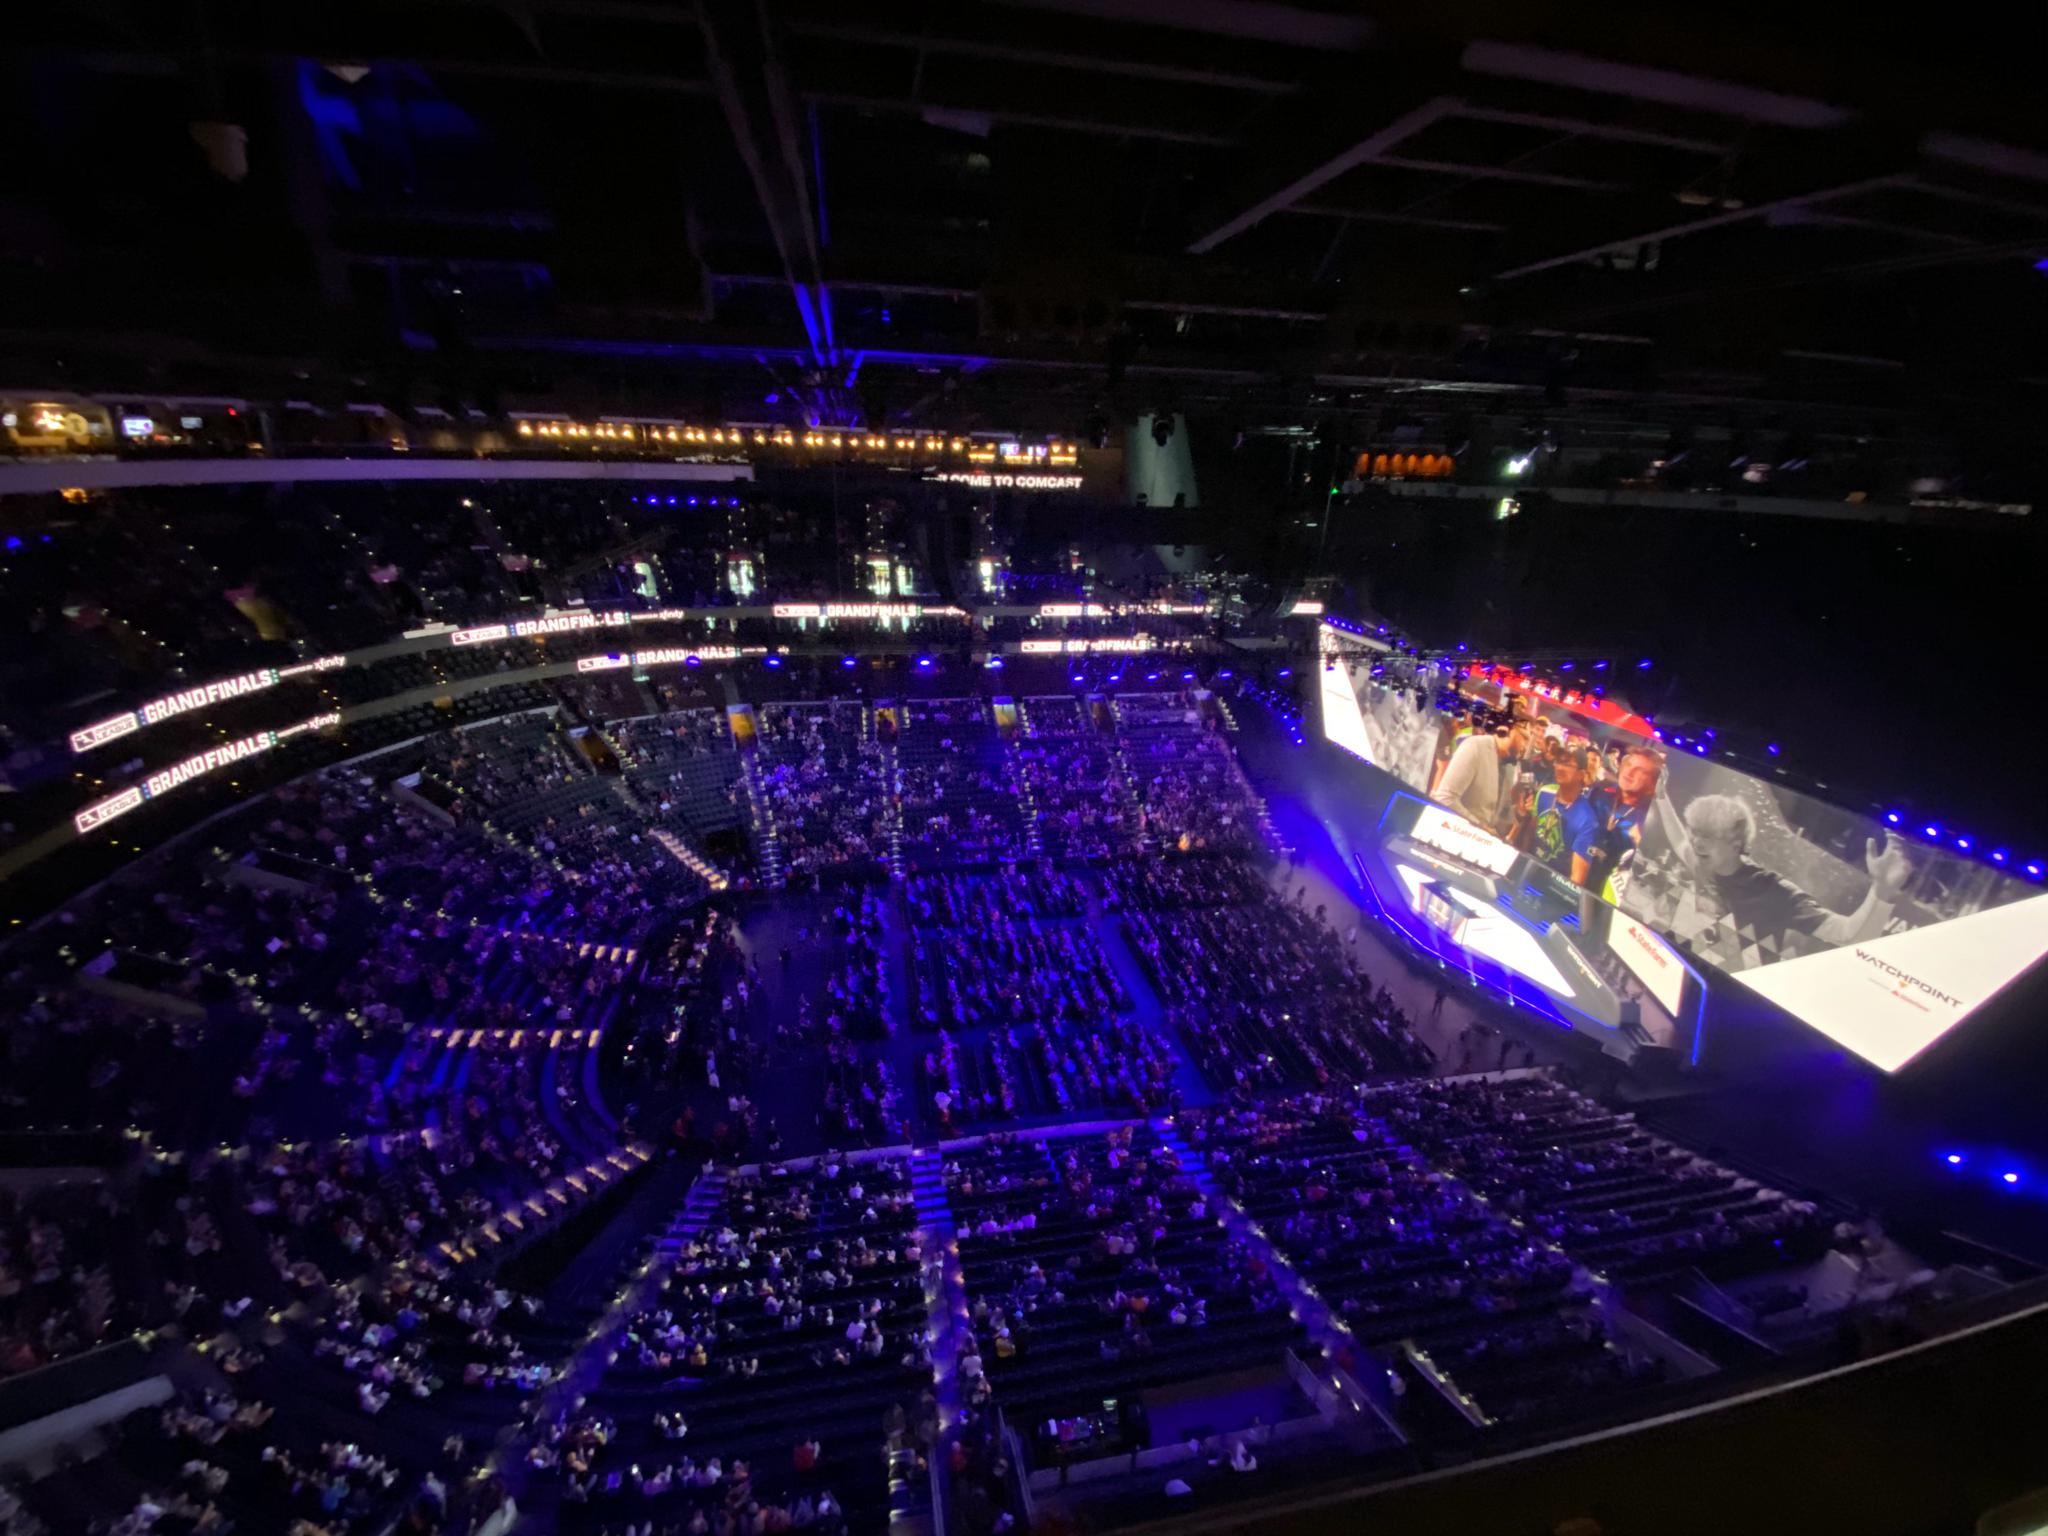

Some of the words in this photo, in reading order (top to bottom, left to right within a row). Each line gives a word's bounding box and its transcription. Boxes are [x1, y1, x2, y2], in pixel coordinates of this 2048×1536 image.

[994, 475, 1013, 487] TO
[1016, 477, 1083, 489] COMCAST
[828, 604, 871, 617] GRAND
[872, 604, 917, 617] FINALS
[515, 619, 570, 636] GRAND
[636, 648, 685, 665] GRAND
[144, 688, 207, 724] GRAND
[205, 669, 273, 703] FINALS
[313, 656, 346, 671] xfinity
[148, 756, 206, 797] GRAND
[203, 732, 272, 771] FINALS
[308, 713, 340, 729] xfinity
[1856, 948, 1964, 1007] WATCHPOINT
